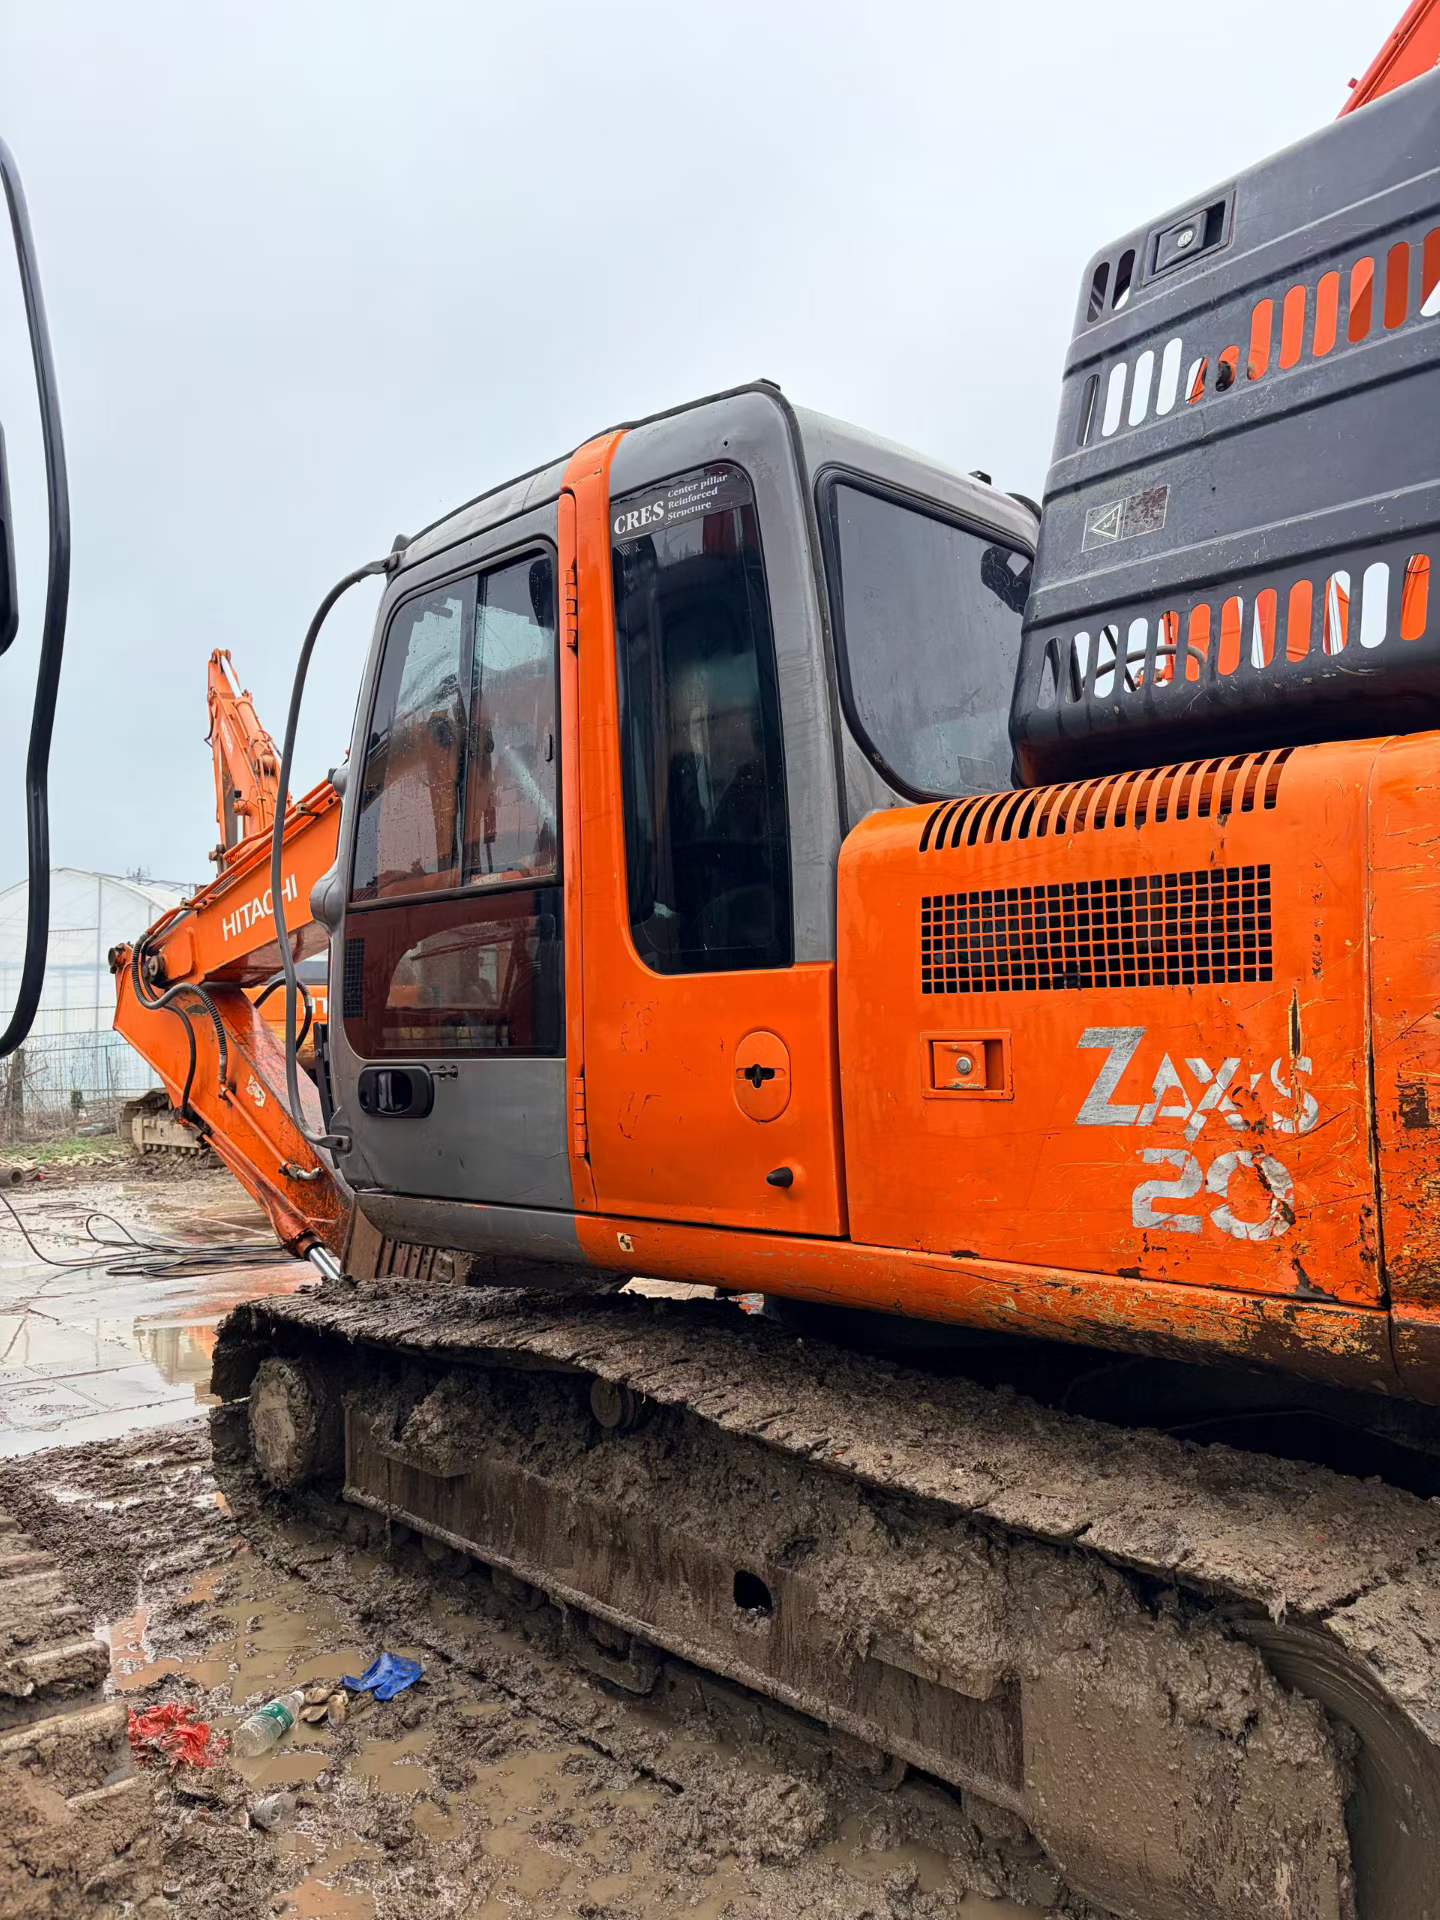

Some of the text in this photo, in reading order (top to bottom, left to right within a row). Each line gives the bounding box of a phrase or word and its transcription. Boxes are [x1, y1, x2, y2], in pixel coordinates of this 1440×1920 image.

[701, 474, 728, 490] pillar
[668, 486, 718, 509] Reinforced
[613, 500, 664, 535] CRES
[667, 501, 712, 521] Structure
[222, 873, 298, 942] HITACHI
